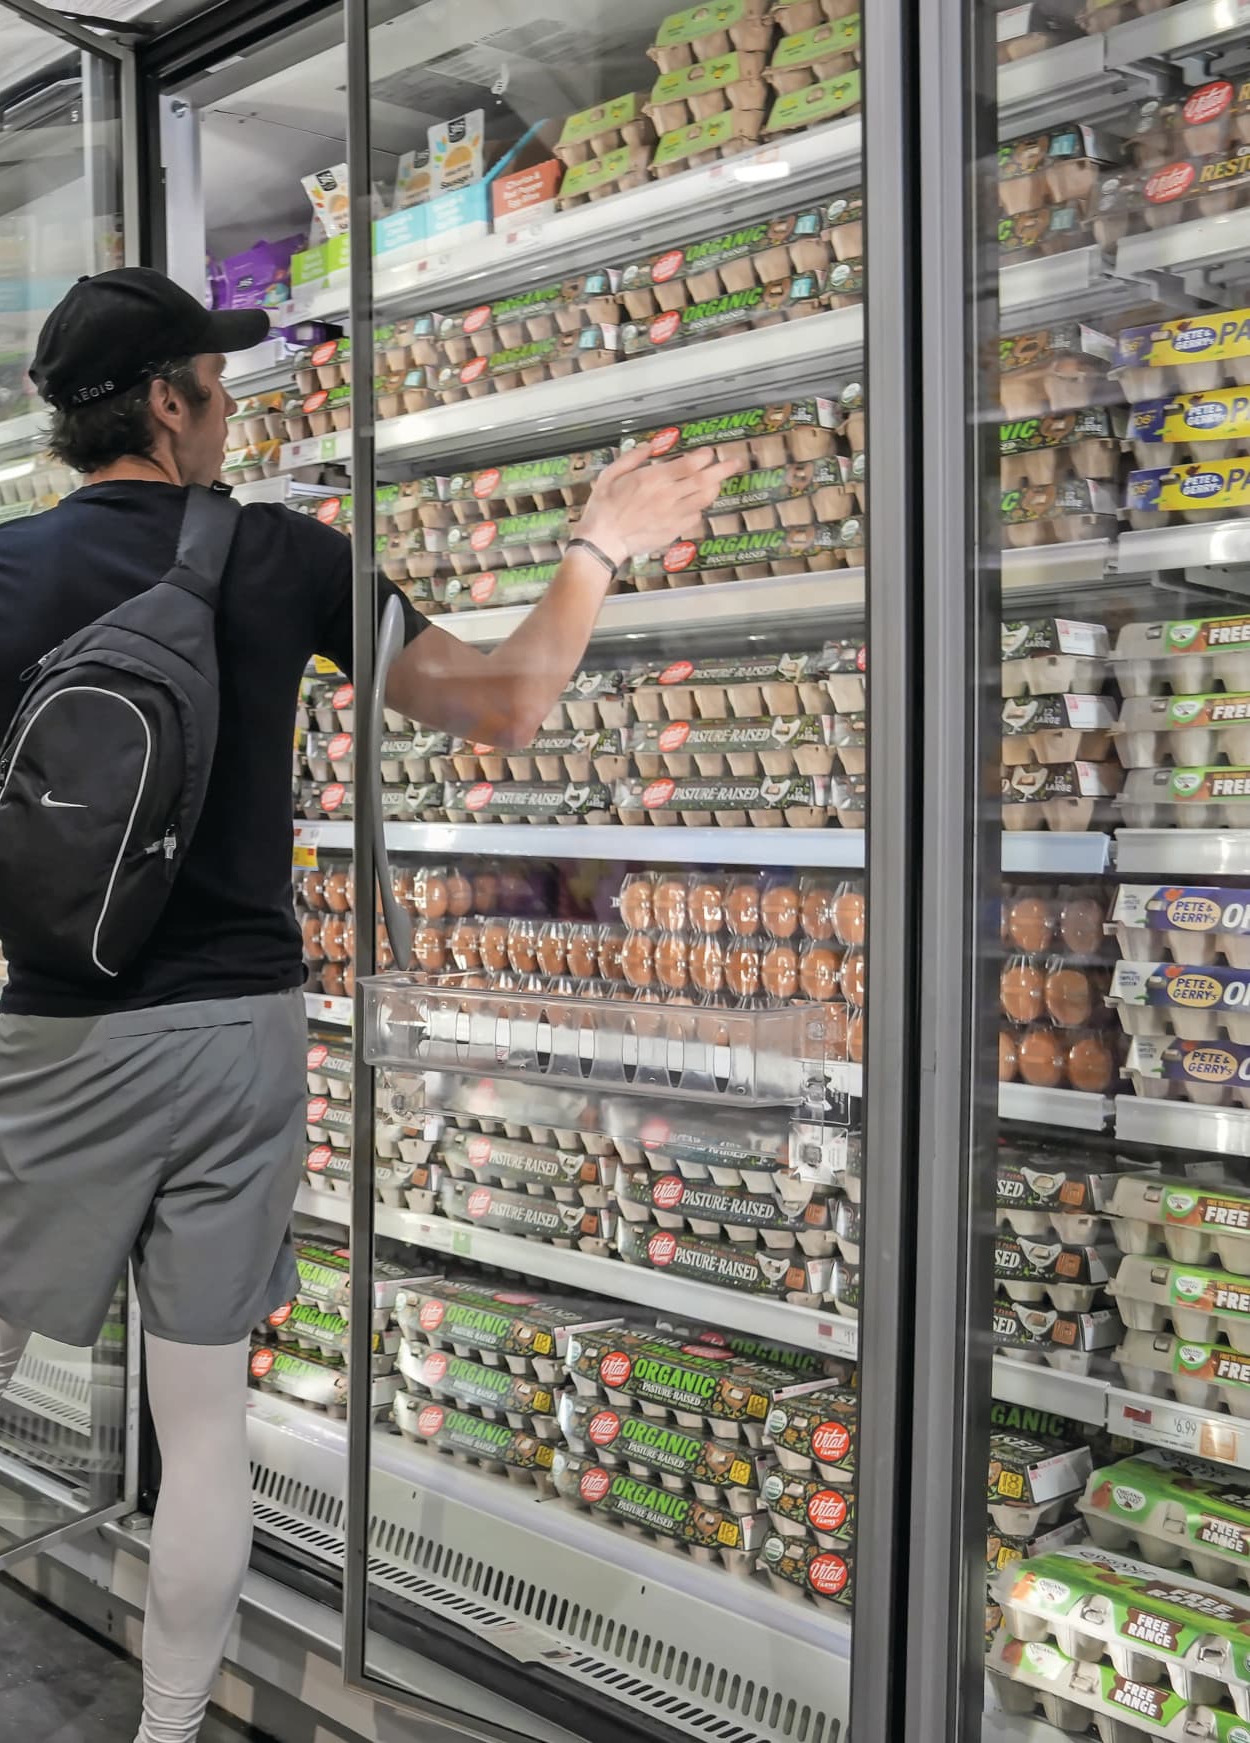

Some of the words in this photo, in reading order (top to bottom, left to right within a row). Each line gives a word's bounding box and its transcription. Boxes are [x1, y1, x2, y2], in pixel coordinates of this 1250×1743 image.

[685, 224, 767, 262] ORGANIC
[682, 286, 764, 324] ORGANIC
[682, 409, 765, 438] ORGANIC
[720, 468, 786, 497] GANIC
[700, 530, 786, 557] ORGANIC
[1209, 626, 1250, 645] FREE
[673, 786, 760, 801] PASTURE-RAISED
[1175, 900, 1206, 912] PETE
[1176, 977, 1206, 989] PETE
[1191, 1051, 1222, 1063] PETE
[489, 1149, 559, 1177] PASTURE-RAISED
[653, 1180, 682, 1200] Vital
[490, 1201, 559, 1228] PASTURE-RAISED
[681, 1189, 775, 1219] PASTURE-RAISED
[1204, 1205, 1250, 1228] FREE
[648, 1236, 676, 1256] Vital
[673, 1247, 759, 1282] PASTURE-RAISED
[291, 1304, 349, 1334] ORGANIC
[444, 1305, 512, 1338] ORGANIC
[448, 1359, 512, 1394] ORGANIC
[600, 1357, 628, 1376] Vital
[634, 1358, 717, 1398] ORGANIC
[641, 1382, 701, 1406] PASTURE-RAISED
[445, 1411, 512, 1447] ORGANIC
[590, 1417, 619, 1434] Vital
[990, 1404, 1065, 1437] GANIC
[622, 1418, 701, 1461] ORGANIC
[813, 1428, 846, 1452] Vital
[627, 1441, 686, 1469] PASTURE-RAISED
[581, 1473, 609, 1492] Vital
[1002, 1473, 1019, 1489] 18
[612, 1475, 689, 1521] ORGANIC
[808, 1497, 842, 1519] Vital
[617, 1499, 675, 1530] PASTURE-RAISED
[1201, 1528, 1245, 1552] RANGE
[1209, 1520, 1241, 1539] FREE
[810, 1561, 843, 1582] Vital
[1127, 1622, 1173, 1649] RANGE
[1136, 1613, 1171, 1634] FREE
[1113, 1689, 1158, 1717] RANGE
[1123, 1680, 1156, 1701] FREE
